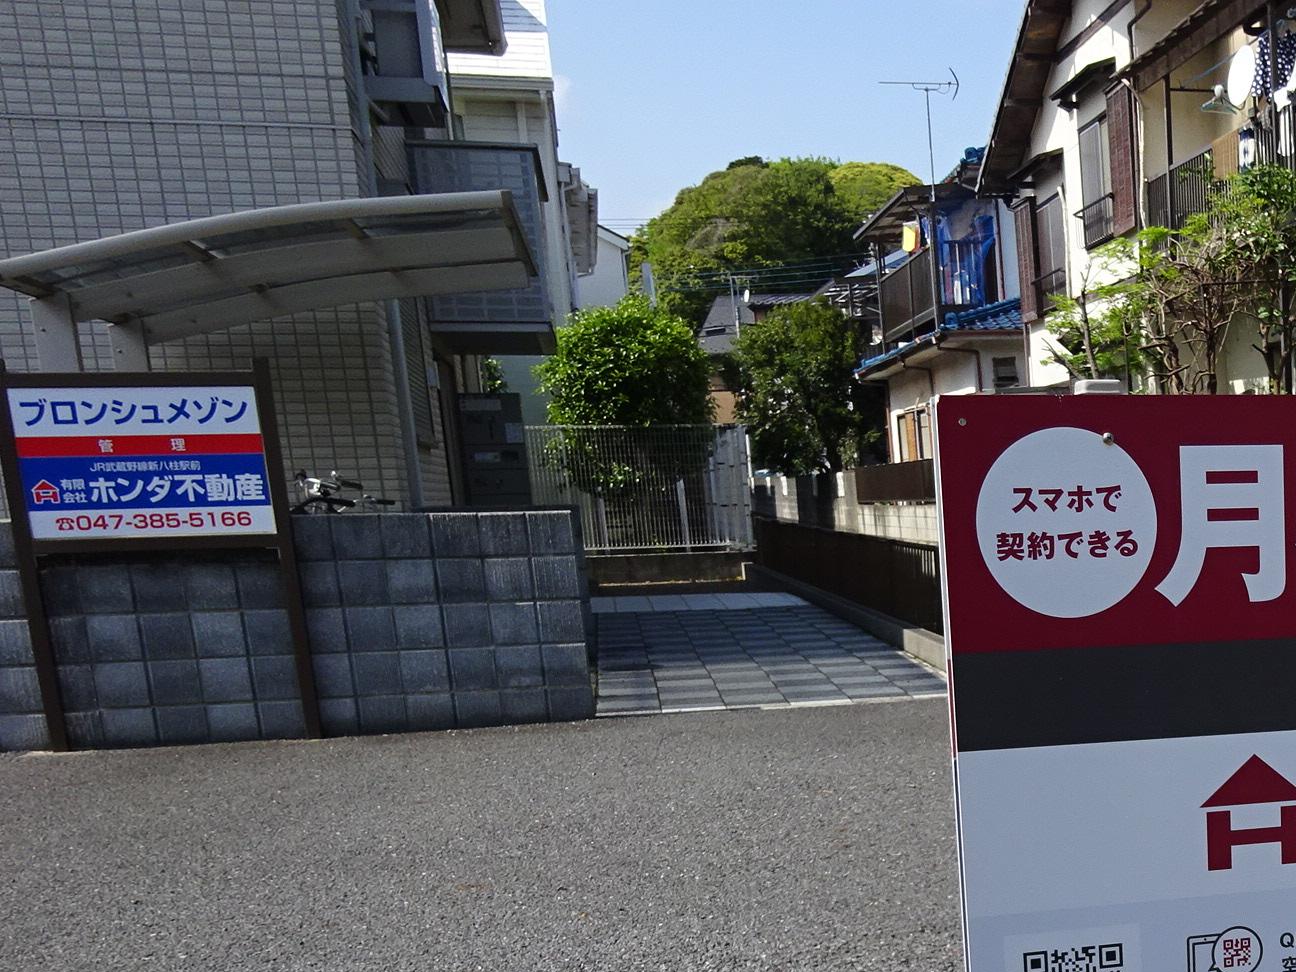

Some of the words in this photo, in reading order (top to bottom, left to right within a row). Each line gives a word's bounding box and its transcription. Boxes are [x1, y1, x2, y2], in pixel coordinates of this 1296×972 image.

[19, 397, 248, 426] ブロンシュメゾン
[98, 438, 187, 453] 管理
[60, 479, 85, 490] 有限
[90, 473, 266, 504] ホンダ不動産
[63, 492, 88, 504] 会社
[1012, 485, 1122, 513] スマホで
[76, 511, 252, 531] 047-385-5166
[996, 530, 1138, 561] 契約できる
